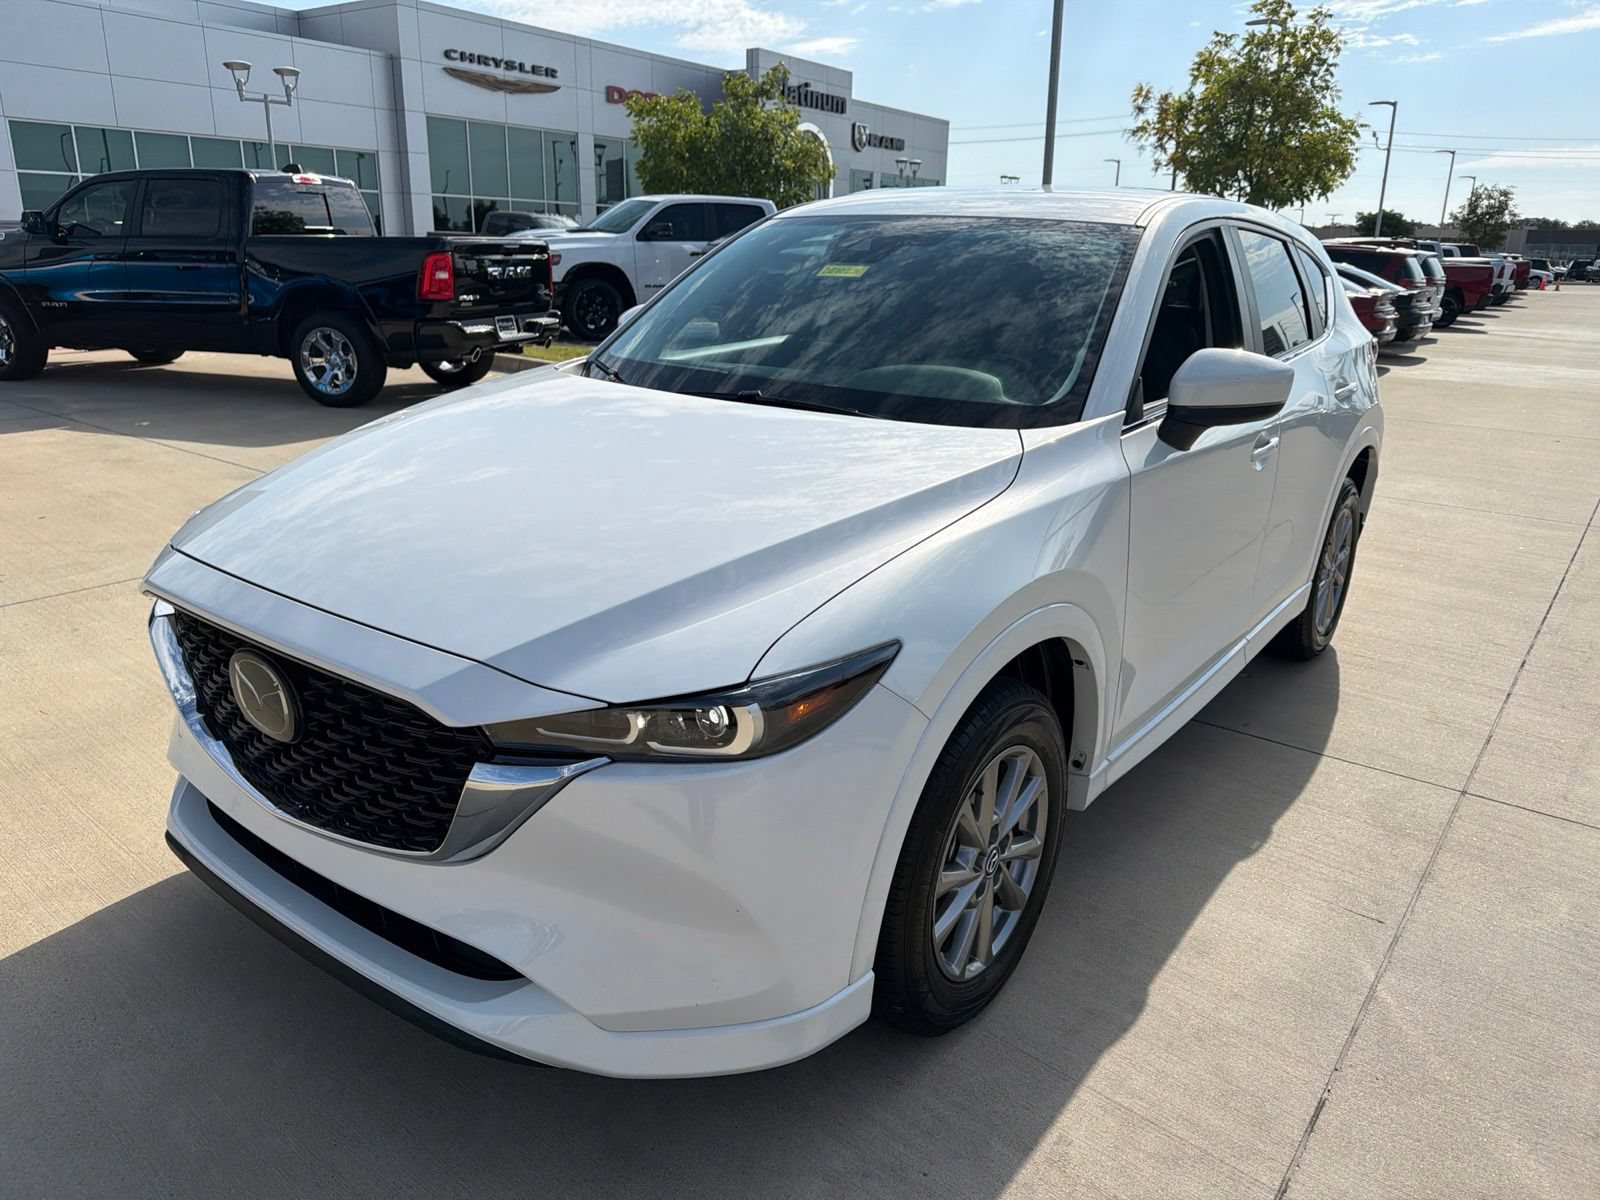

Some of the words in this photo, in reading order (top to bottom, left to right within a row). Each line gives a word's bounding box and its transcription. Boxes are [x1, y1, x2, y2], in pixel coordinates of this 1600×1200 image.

[444, 48, 559, 79] CHRYSLER
[781, 79, 847, 115] latinum
[868, 133, 905, 152] RAM
[487, 265, 532, 280] RAM
